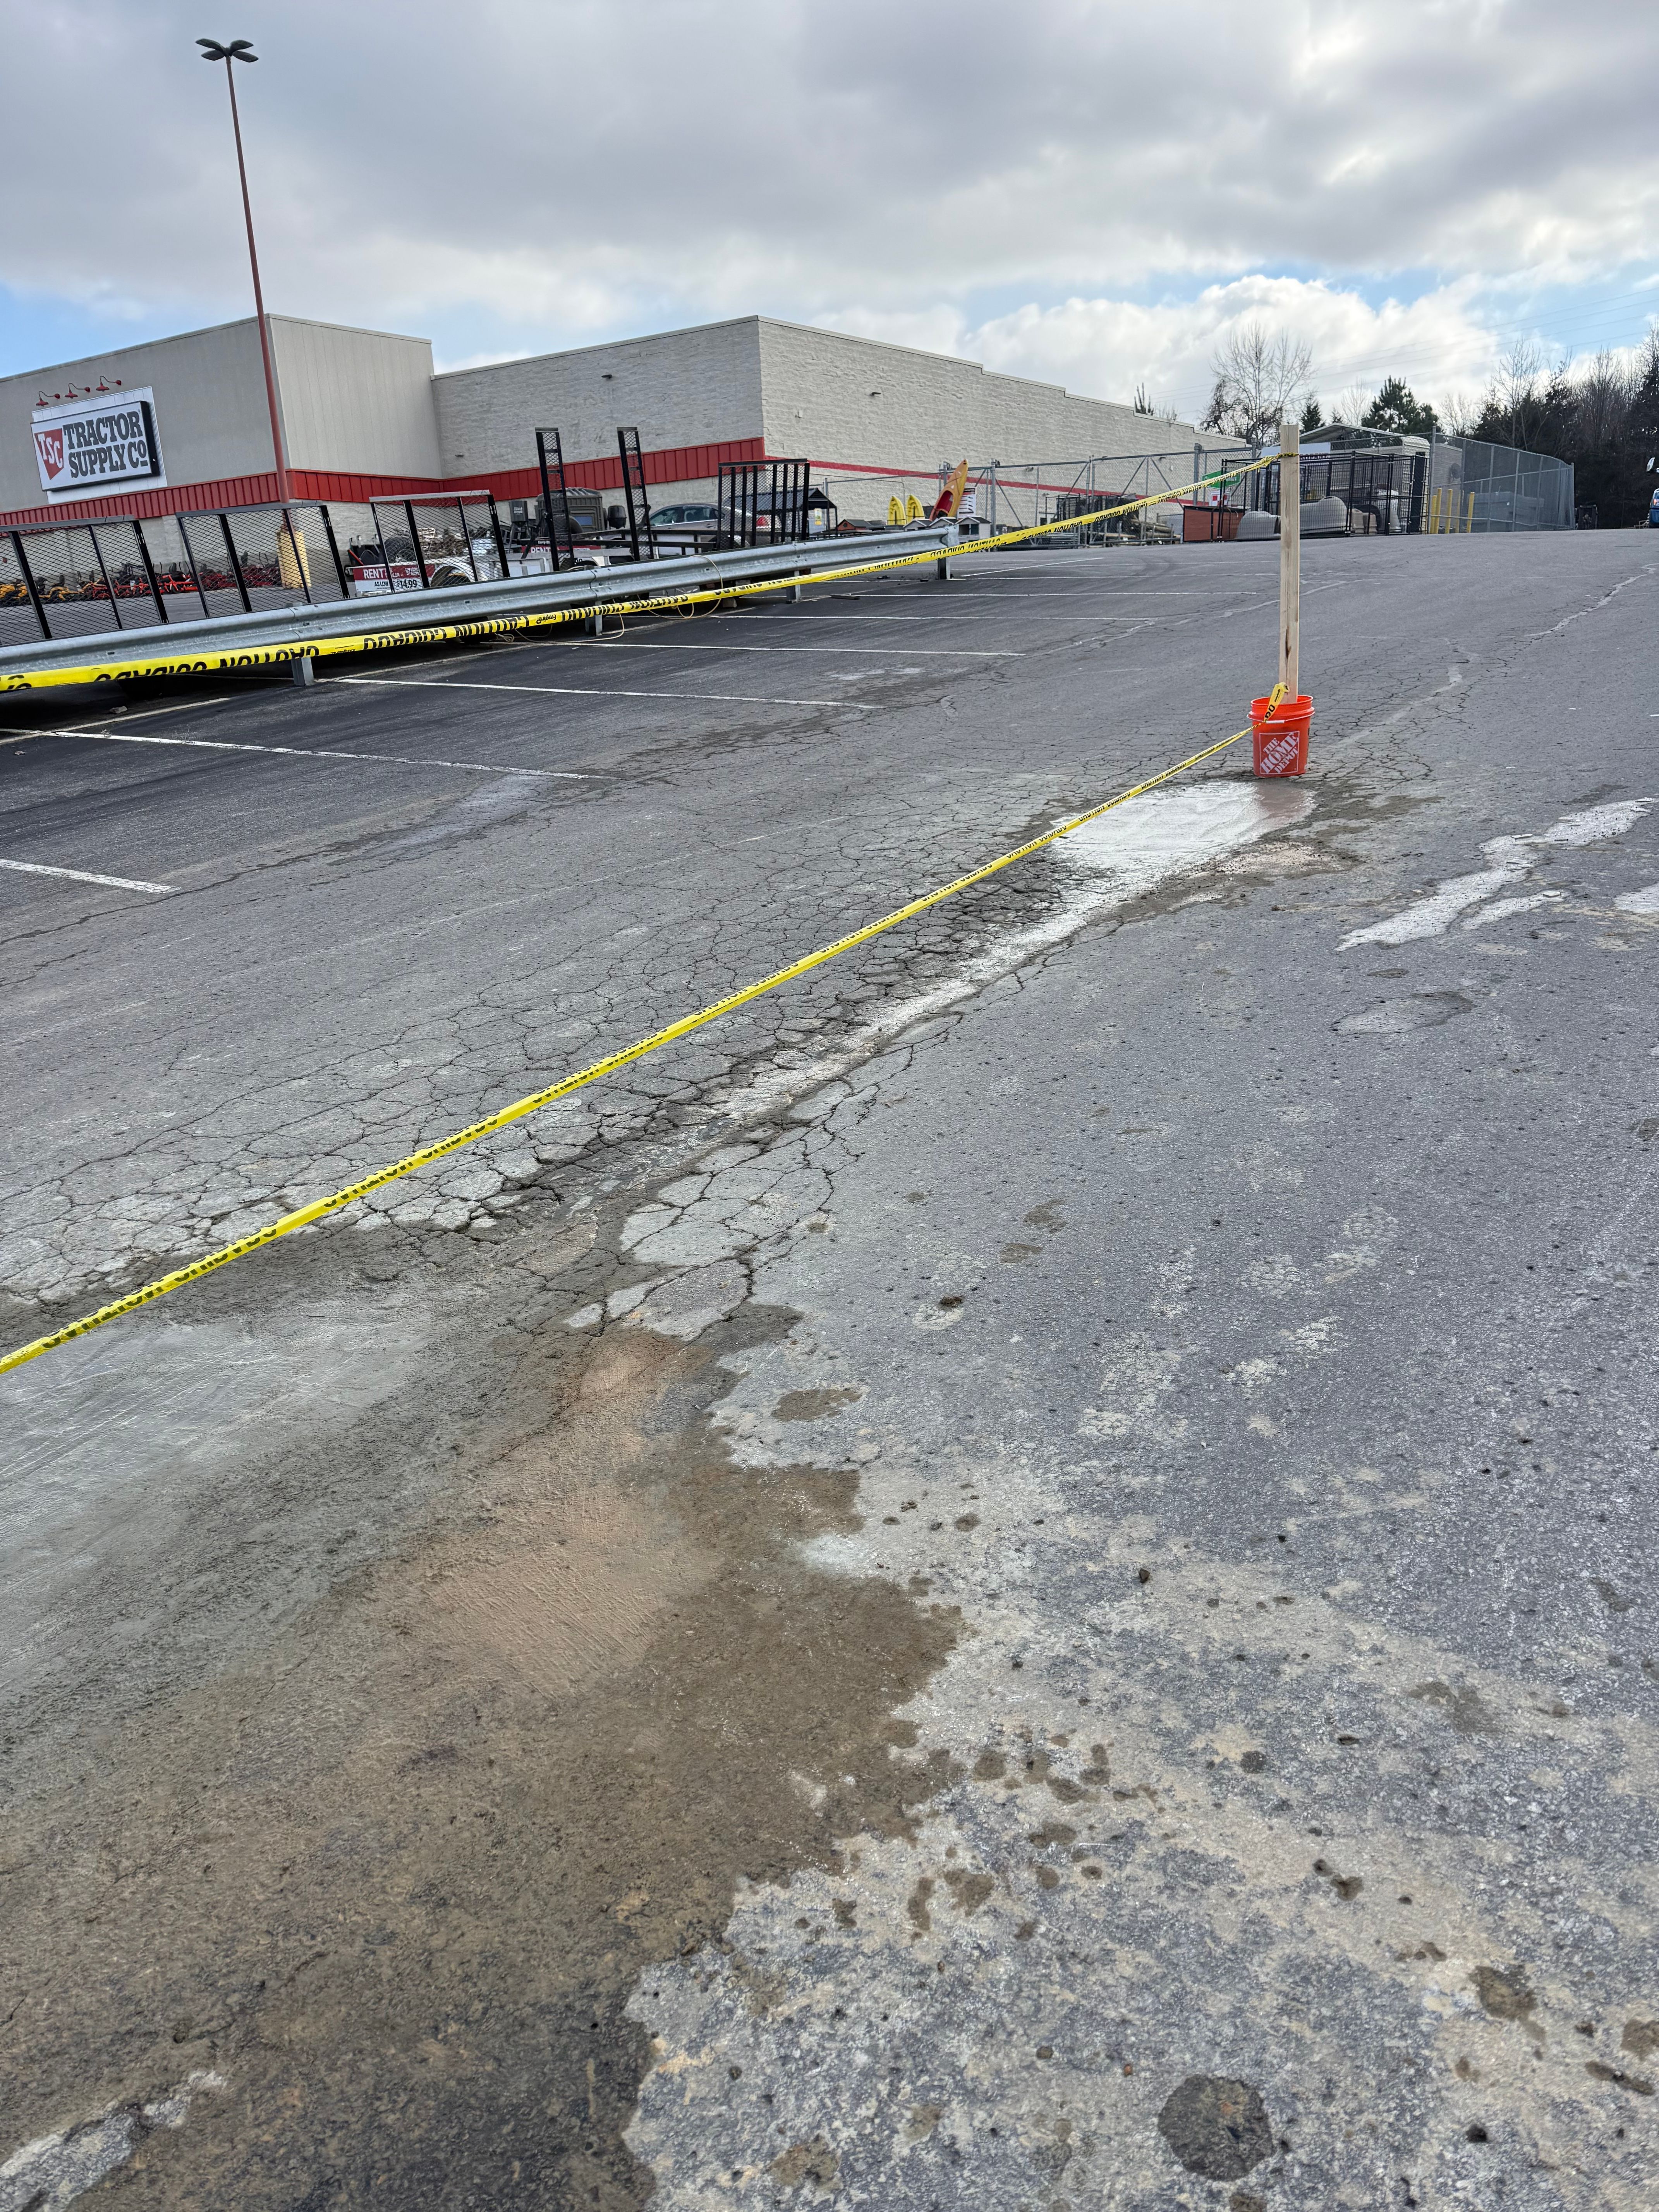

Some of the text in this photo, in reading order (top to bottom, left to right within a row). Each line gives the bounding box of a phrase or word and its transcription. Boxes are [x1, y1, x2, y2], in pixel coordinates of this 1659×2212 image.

[62, 411, 143, 449] TRACTOR
[36, 433, 64, 468] TSC
[68, 443, 126, 478] SUPPLY
[363, 568, 384, 579] RENT
[397, 579, 417, 588] $14.99
[1261, 732, 1299, 773] HOME
[1262, 738, 1280, 754] THE
[1274, 747, 1298, 773] DEPOT
